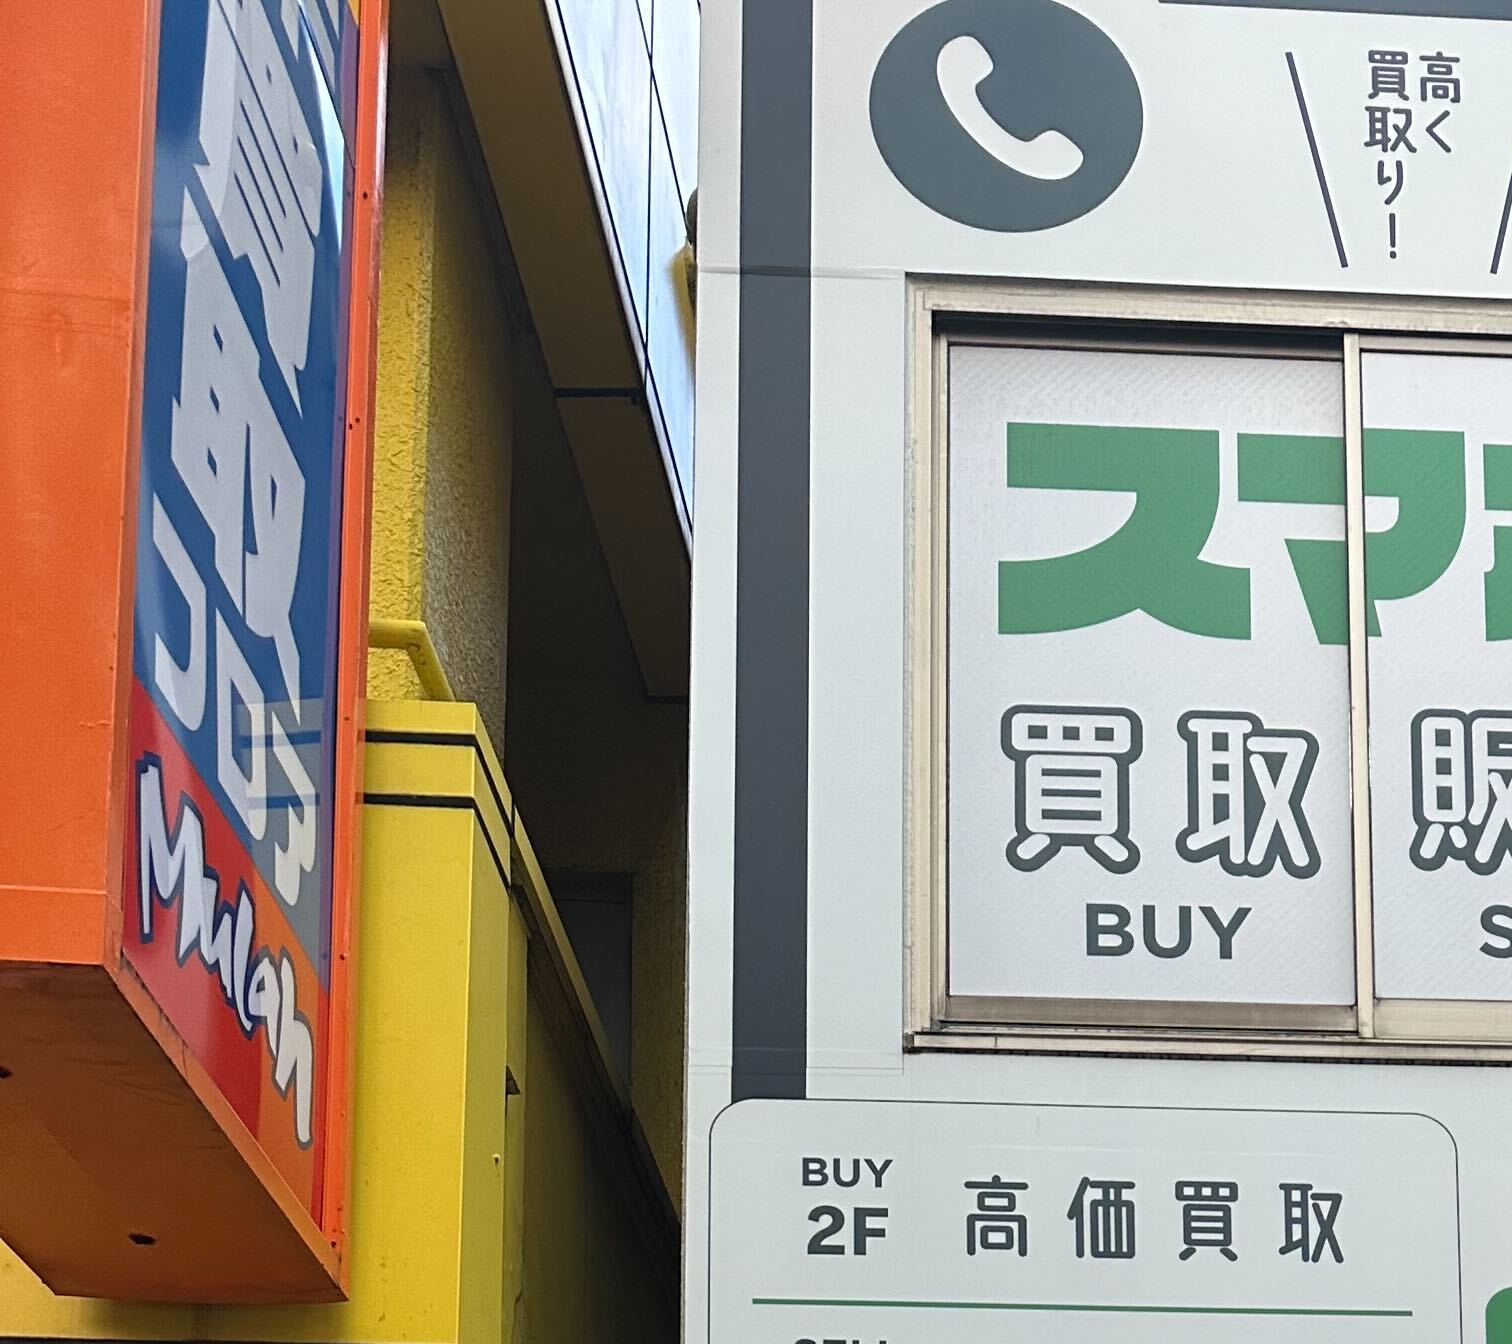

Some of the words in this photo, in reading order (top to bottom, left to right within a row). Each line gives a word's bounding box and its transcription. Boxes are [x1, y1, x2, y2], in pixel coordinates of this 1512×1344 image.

[1418, 50, 1463, 156] 高く
[1000, 703, 1322, 878] 買取
[134, 750, 314, 1150] Mulan
[1084, 903, 1254, 960] BUY
[800, 1156, 894, 1190] BUY
[804, 1204, 890, 1258] 2F
[962, 1174, 1347, 1266] 高価買取
